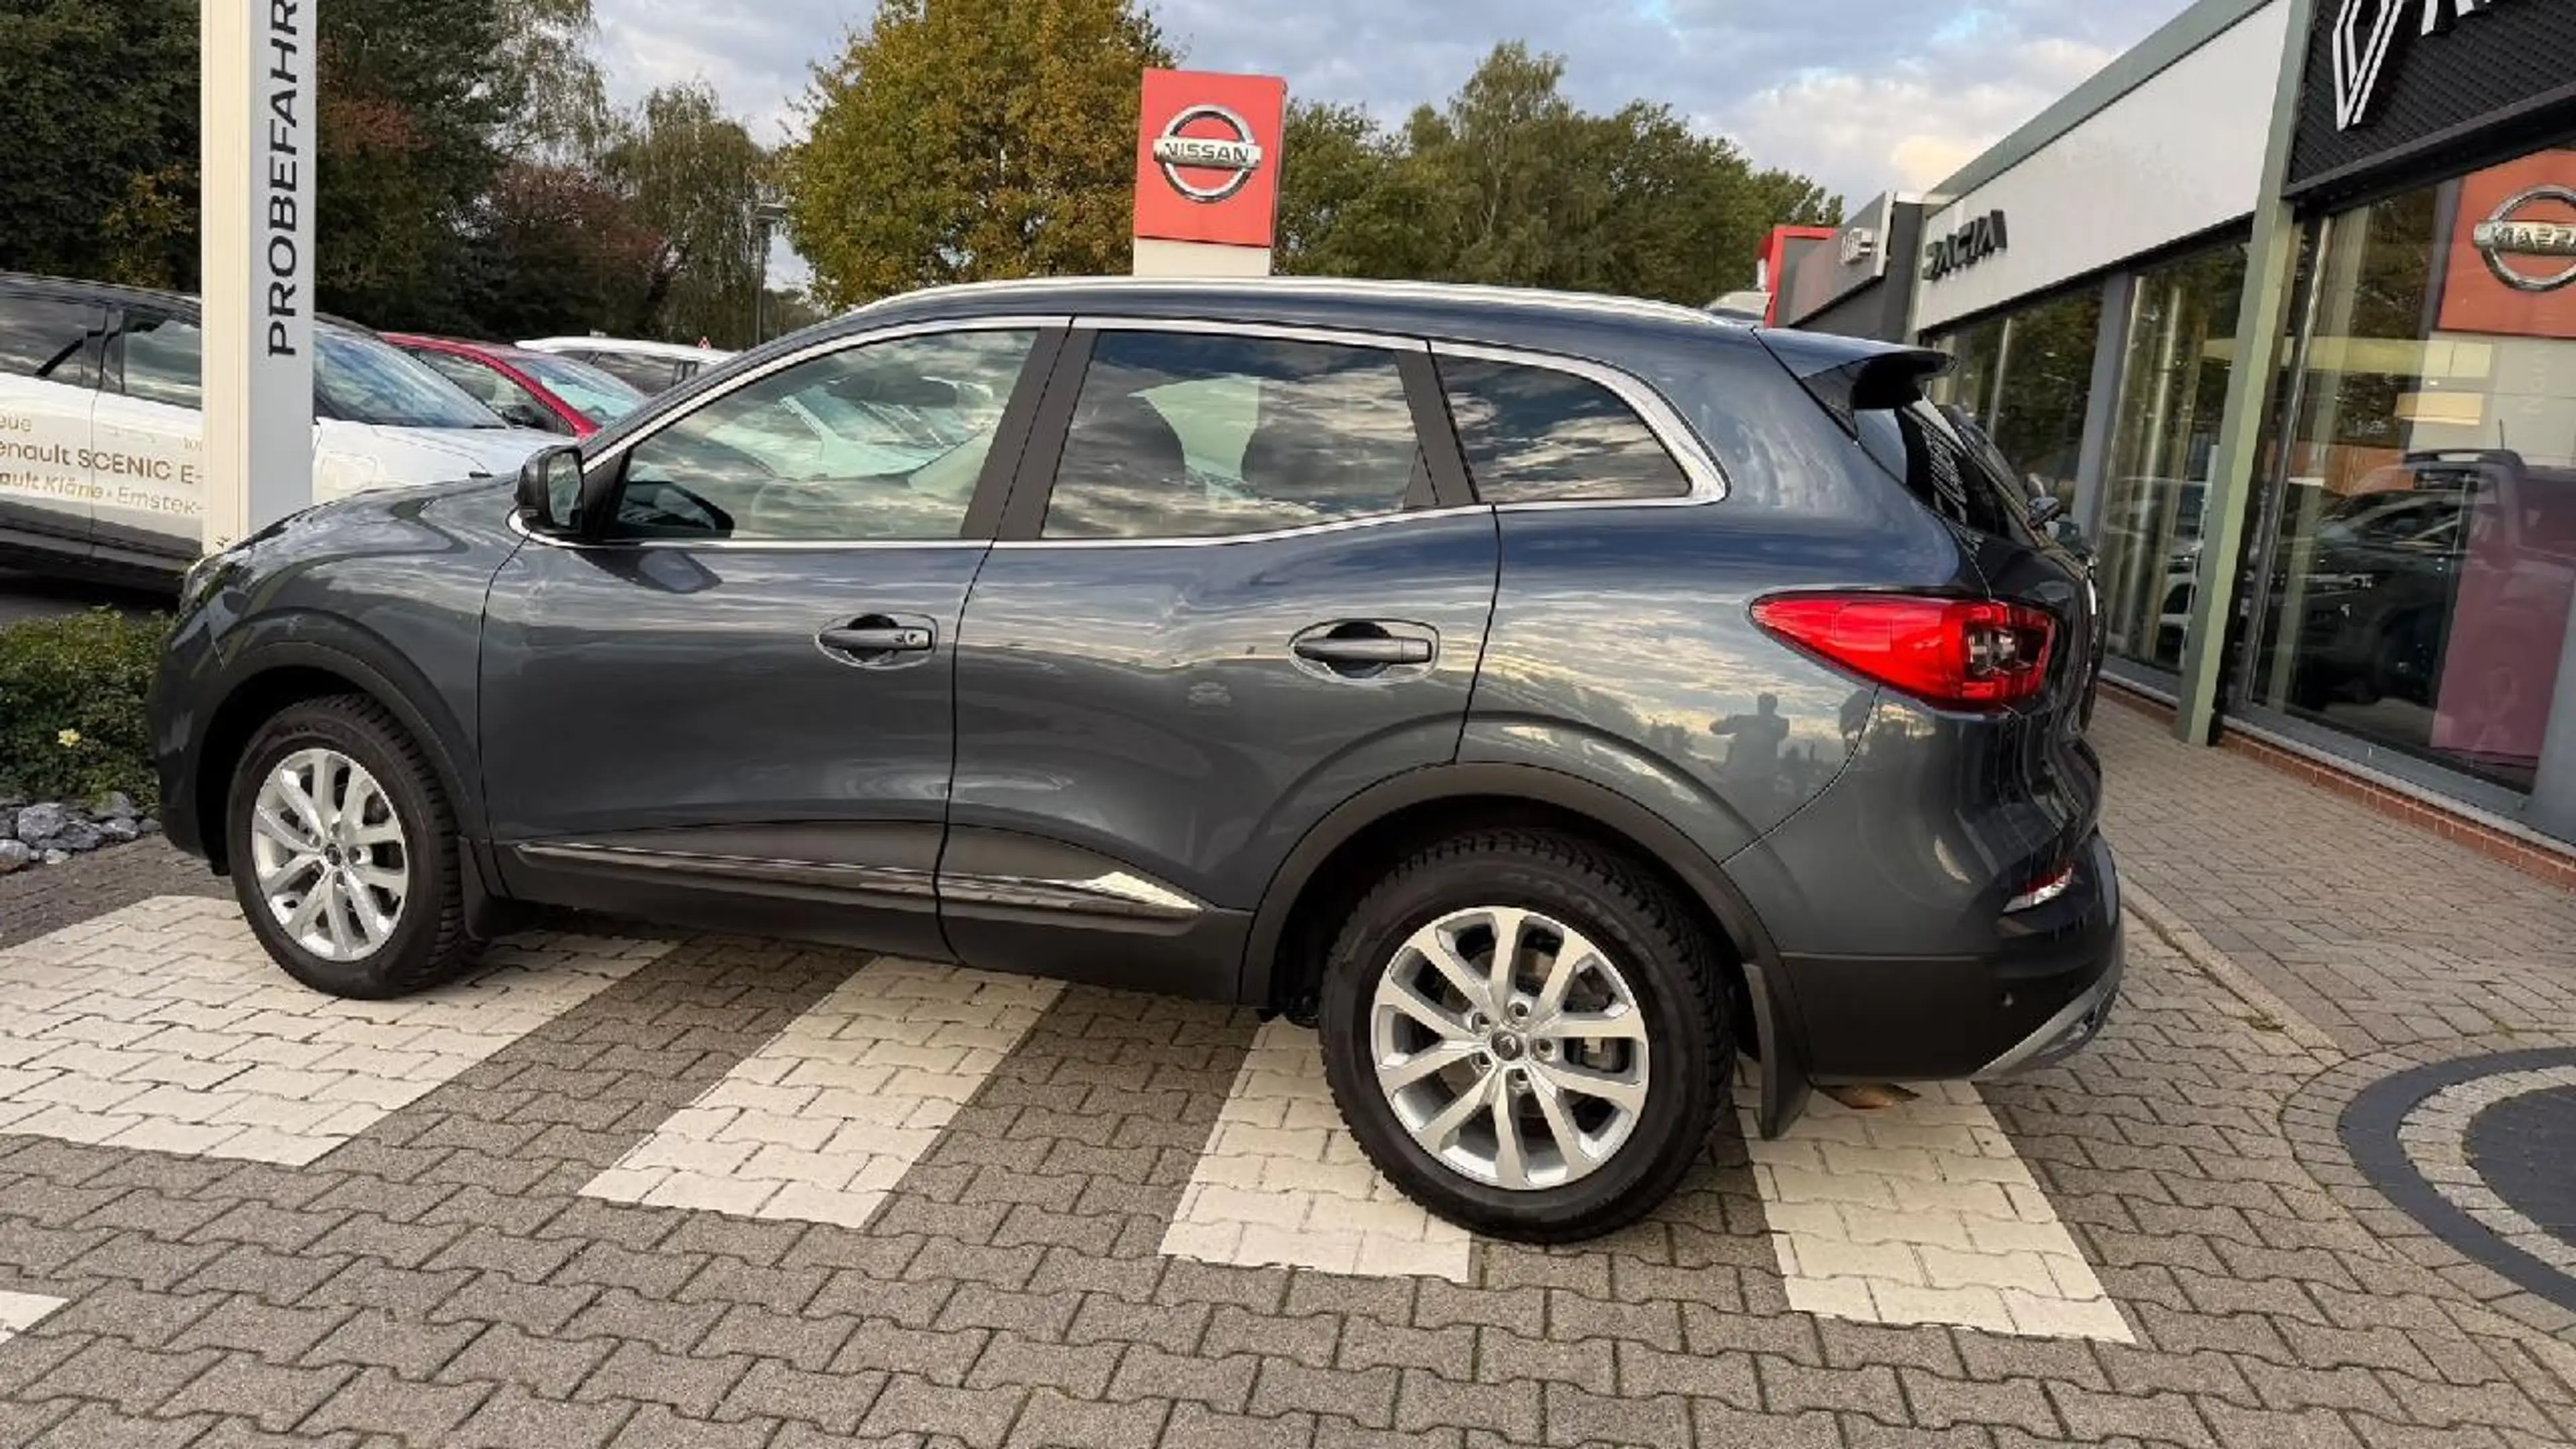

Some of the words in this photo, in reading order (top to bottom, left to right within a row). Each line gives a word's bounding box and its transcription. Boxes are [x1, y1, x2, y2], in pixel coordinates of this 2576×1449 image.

[1165, 142, 1249, 162] NISSAN
[269, 0, 297, 356] PROBEFAHR
[0, 416, 32, 431] eue
[0, 441, 70, 466] enault
[78, 448, 170, 480] SCENIC
[181, 464, 204, 484] E-
[117, 486, 206, 514] Emstek-
